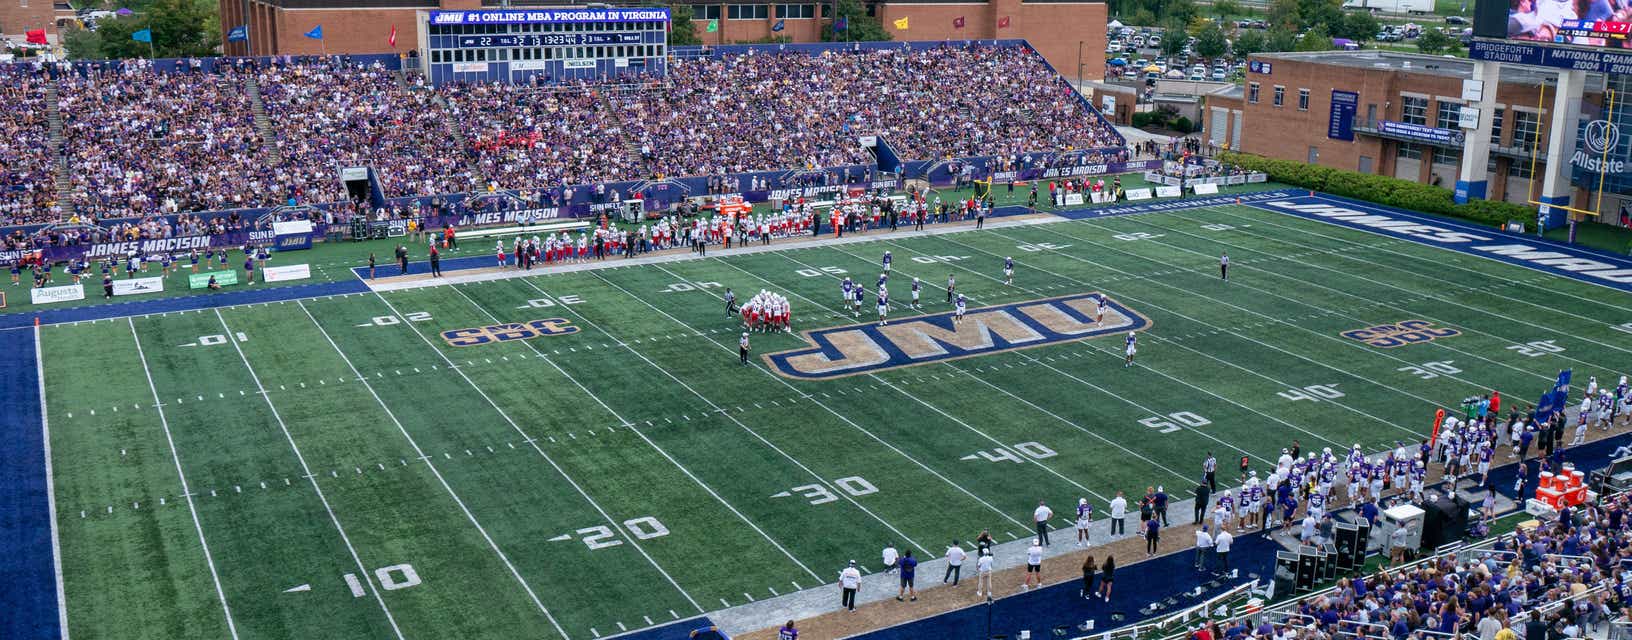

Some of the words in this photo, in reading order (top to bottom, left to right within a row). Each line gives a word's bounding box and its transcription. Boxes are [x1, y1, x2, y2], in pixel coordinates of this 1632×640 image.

[435, 12, 464, 23] JMU
[468, 13, 480, 22] #1
[482, 12, 525, 22] ONLINE
[527, 12, 552, 21] MBA
[554, 12, 606, 21] PROGRAM
[608, 12, 620, 20] IN
[622, 11, 668, 20] VIRGINIA
[480, 37, 491, 46] 22
[1475, 42, 1534, 56] BRIDGEFORTH
[1551, 50, 1601, 62] NATIONAL
[1483, 51, 1522, 63] STADIUM
[1573, 60, 1600, 71] 2004
[1569, 150, 1624, 173] Allstate
[1266, 200, 1494, 243] JAMES
[85, 241, 139, 257] JAMES
[795, 265, 849, 277] 50
[528, 295, 588, 308] 30
[372, 311, 433, 326] 20
[199, 332, 248, 346] 10
[440, 318, 581, 347] SBC
[768, 293, 1147, 379] JMU
[1506, 340, 1567, 358] 20
[1397, 360, 1463, 380] 30
[1277, 384, 1347, 402] 40
[1138, 411, 1212, 434] 50
[976, 441, 1059, 464] 40
[791, 475, 880, 505] 30
[576, 516, 671, 550] 20
[343, 563, 422, 598] 10
